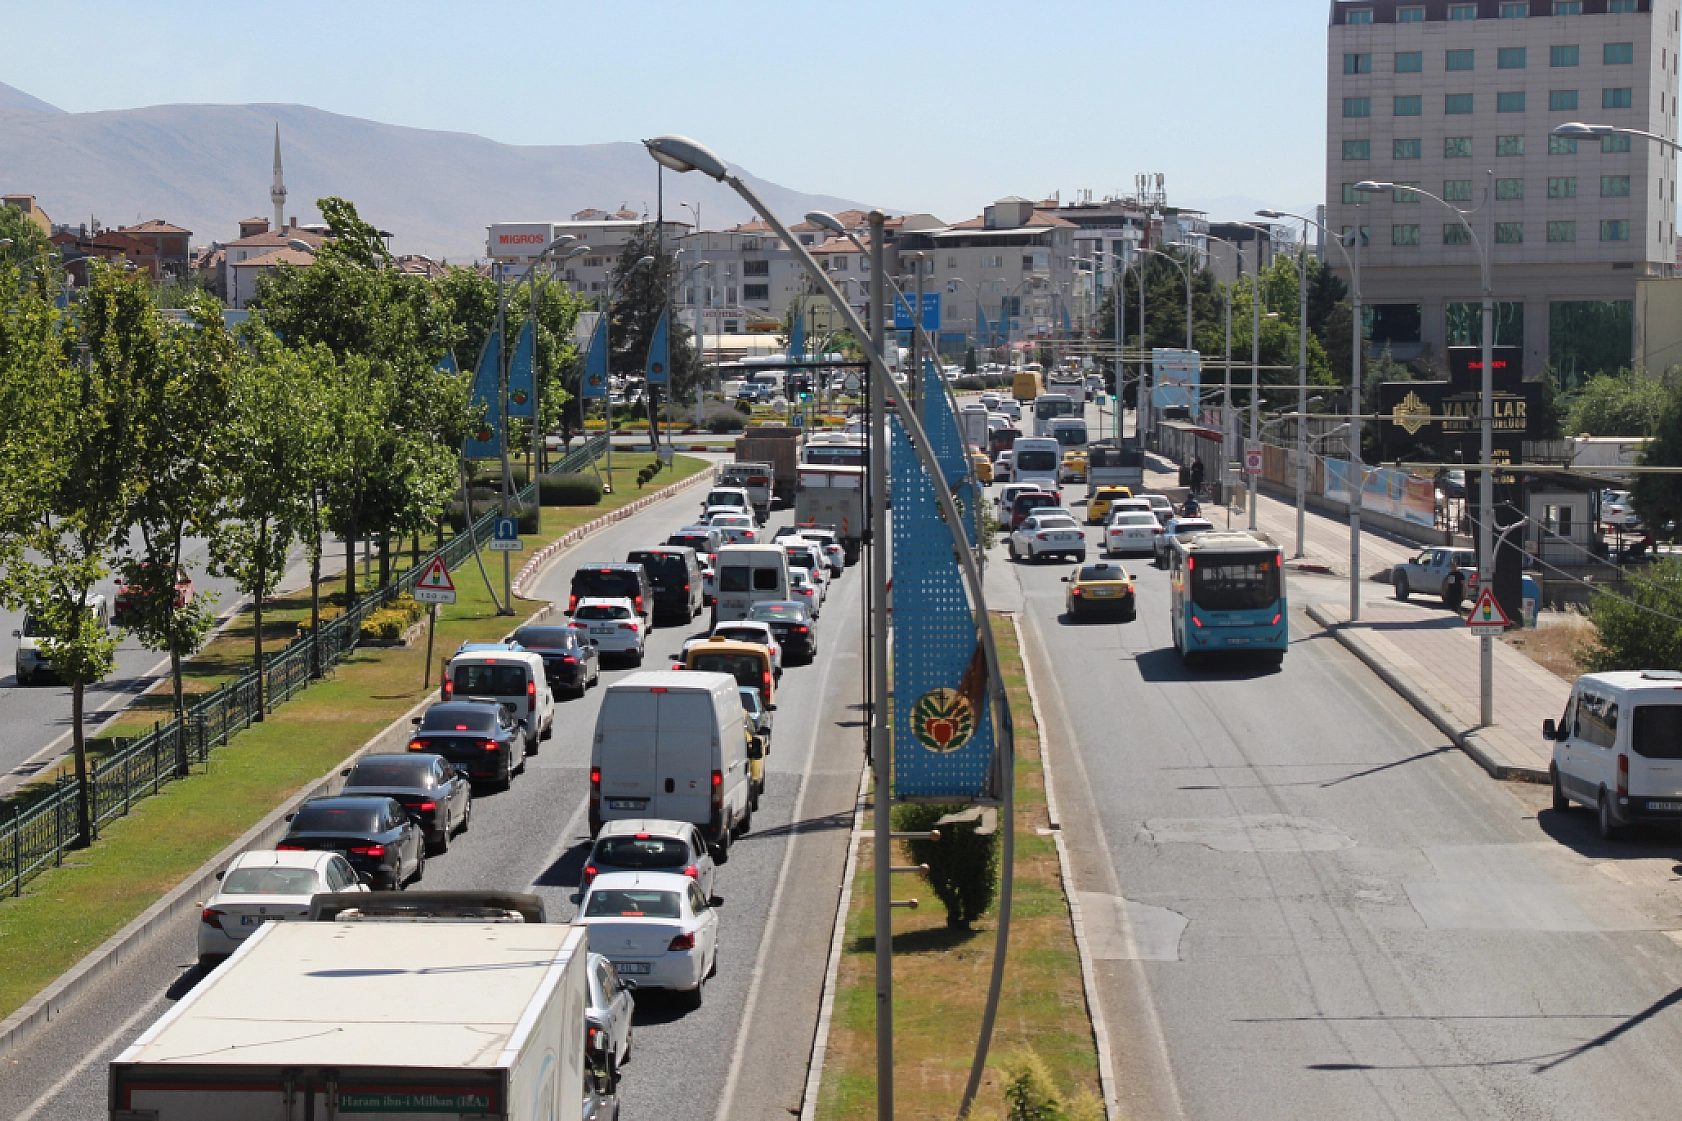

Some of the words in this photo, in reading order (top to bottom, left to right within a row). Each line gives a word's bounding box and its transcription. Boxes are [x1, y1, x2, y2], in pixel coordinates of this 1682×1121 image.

[499, 234, 544, 245] MIGROS
[1442, 402, 1527, 418] VAKILAR
[342, 1095, 380, 1107] Haram
[383, 1095, 410, 1107] ibn-i
[413, 1095, 454, 1107] Milhan
